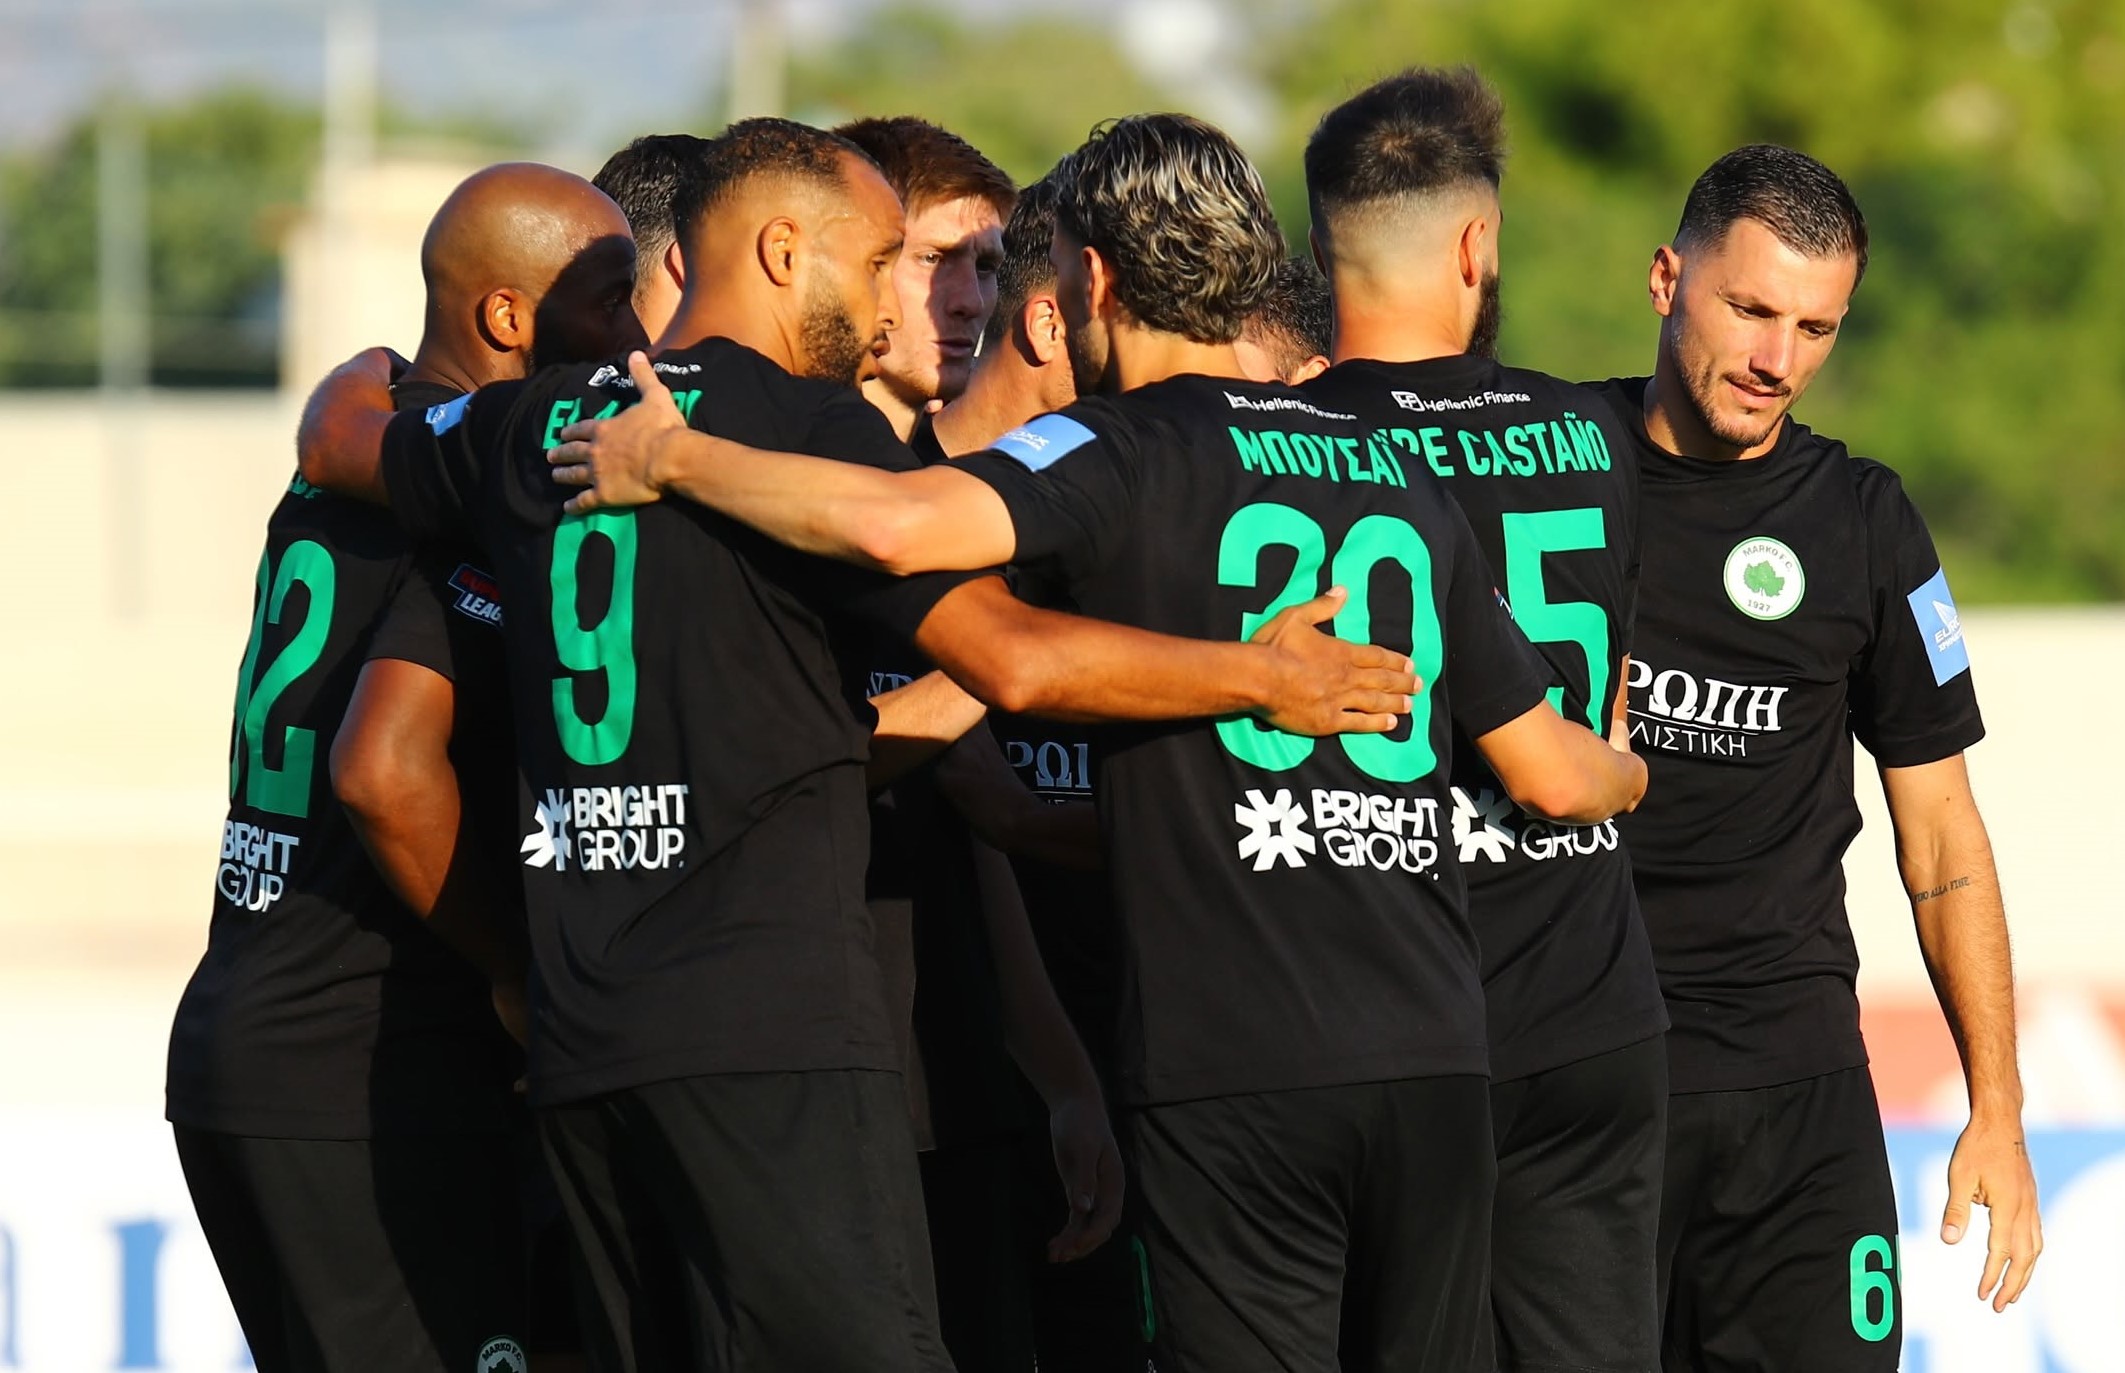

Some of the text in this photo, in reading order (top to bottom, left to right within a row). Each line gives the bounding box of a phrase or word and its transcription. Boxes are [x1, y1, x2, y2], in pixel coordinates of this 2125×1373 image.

[1252, 397, 1310, 413] Hellenic
[1423, 391, 1531, 412] Hellenic Finance
[1457, 411, 1611, 478] CASTAÑO
[1742, 545, 1779, 557] MARKO
[1502, 508, 1609, 737] 5
[1747, 600, 1771, 612] 1927
[551, 508, 637, 766] 9
[1215, 503, 1443, 783] 30
[230, 540, 335, 818] 2
[572, 784, 689, 828] BRIGHT
[1311, 788, 1438, 838] BRIGHT
[1850, 1234, 1902, 1342] 6
[482, 1341, 511, 1361] MARKO
